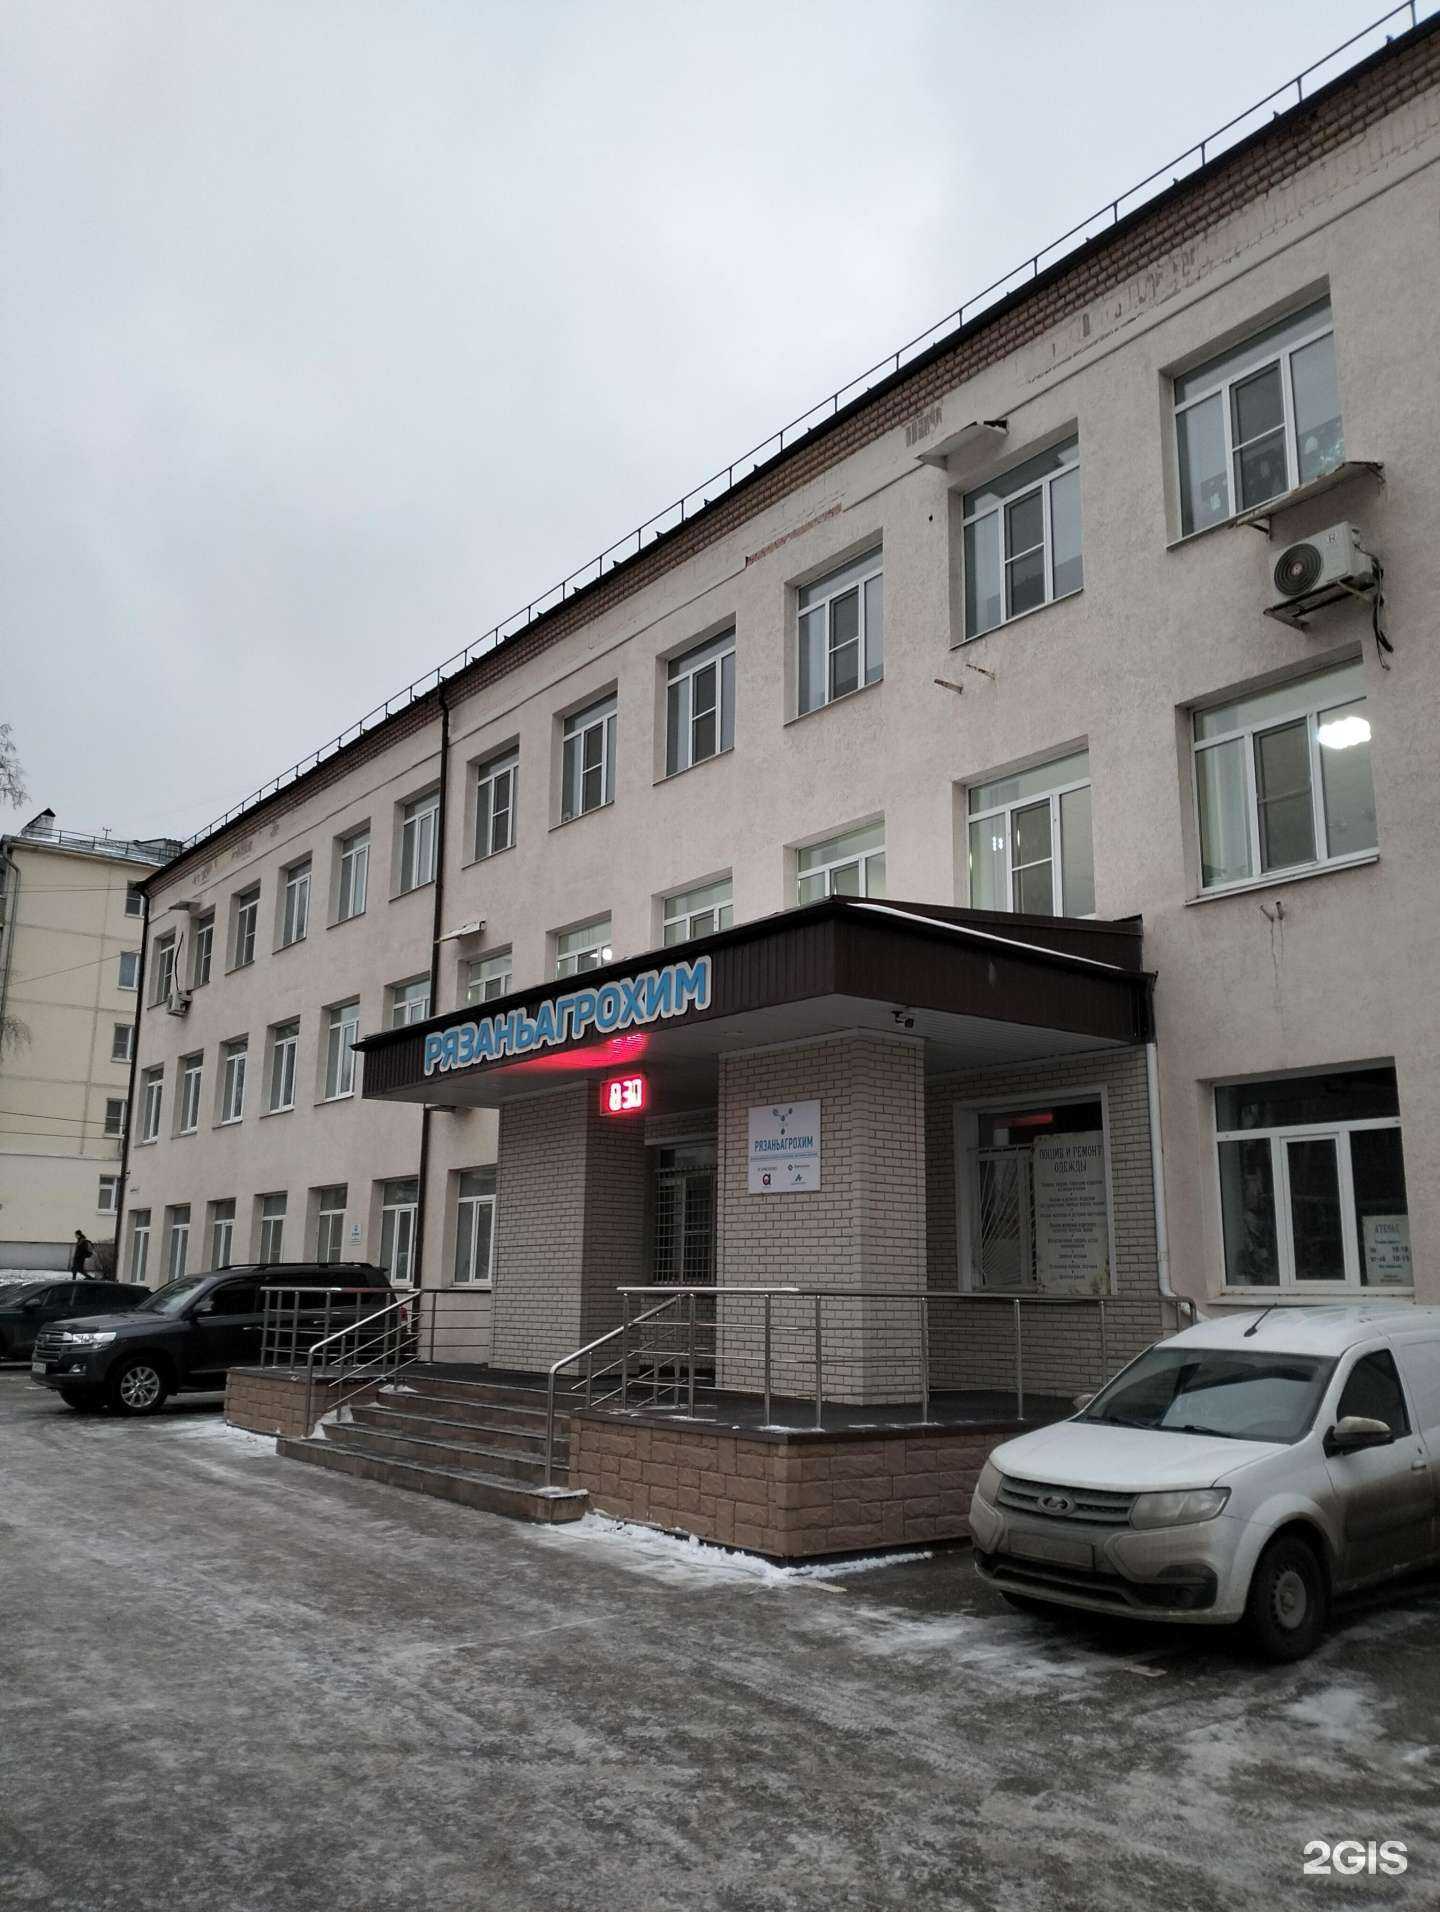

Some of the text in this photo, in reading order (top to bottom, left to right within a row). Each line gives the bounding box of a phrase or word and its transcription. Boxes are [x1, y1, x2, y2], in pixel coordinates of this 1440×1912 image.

[424, 956, 711, 1076] РЯЗАНЬАГРОХИМ
[754, 1136, 814, 1152] РЯЗАНЬАГРОХИМ
[1073, 1144, 1103, 1158] РЕМОНТ
[1054, 1160, 1087, 1174] ОДЕЖДЫ
